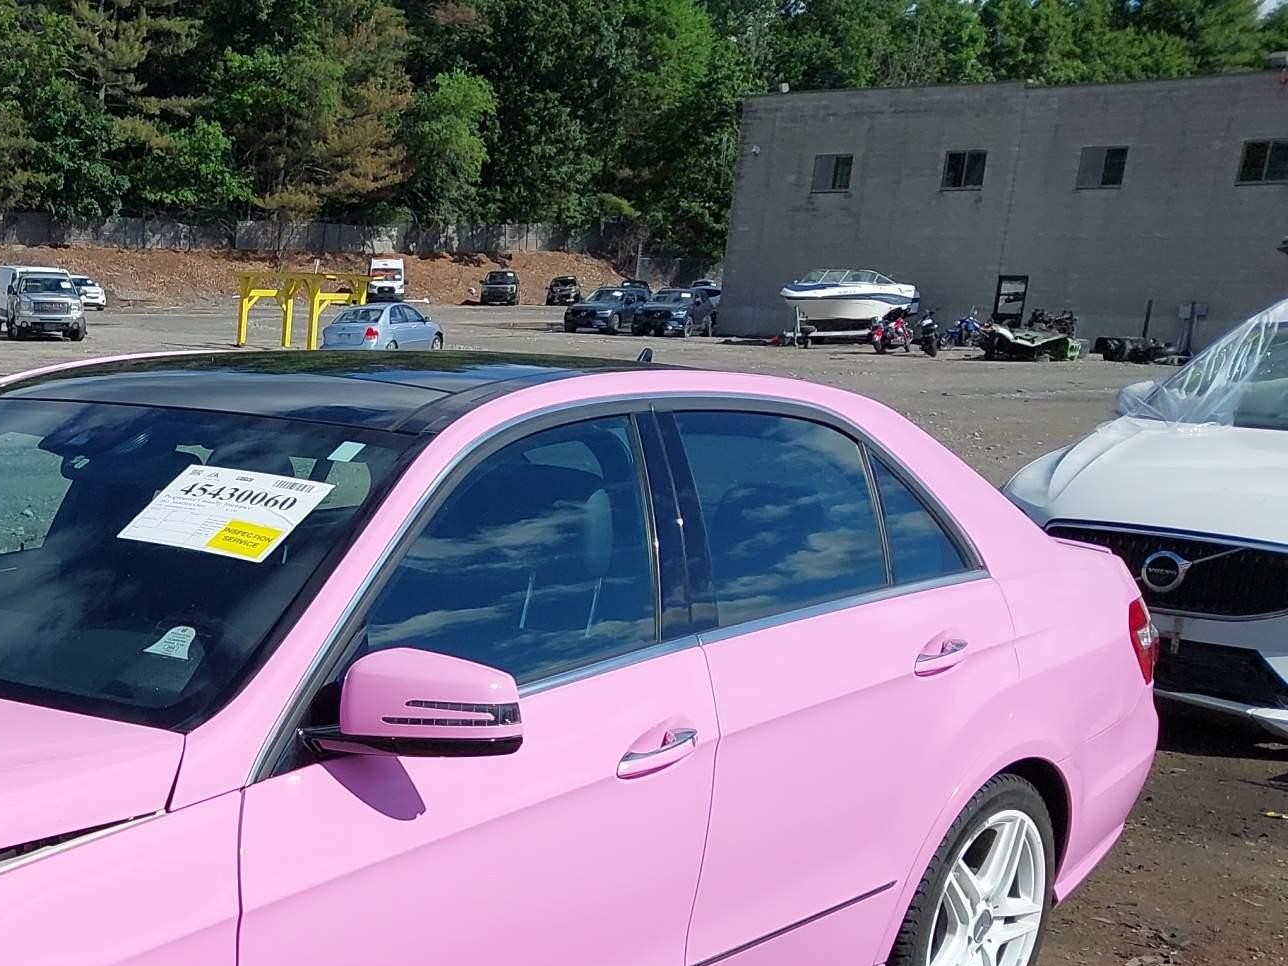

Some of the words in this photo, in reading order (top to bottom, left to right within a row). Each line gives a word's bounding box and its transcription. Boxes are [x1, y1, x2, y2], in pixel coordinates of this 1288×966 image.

[180, 482, 297, 511] 45430060
[222, 535, 260, 549] SERVICE
[223, 527, 273, 543] INSPECTION
